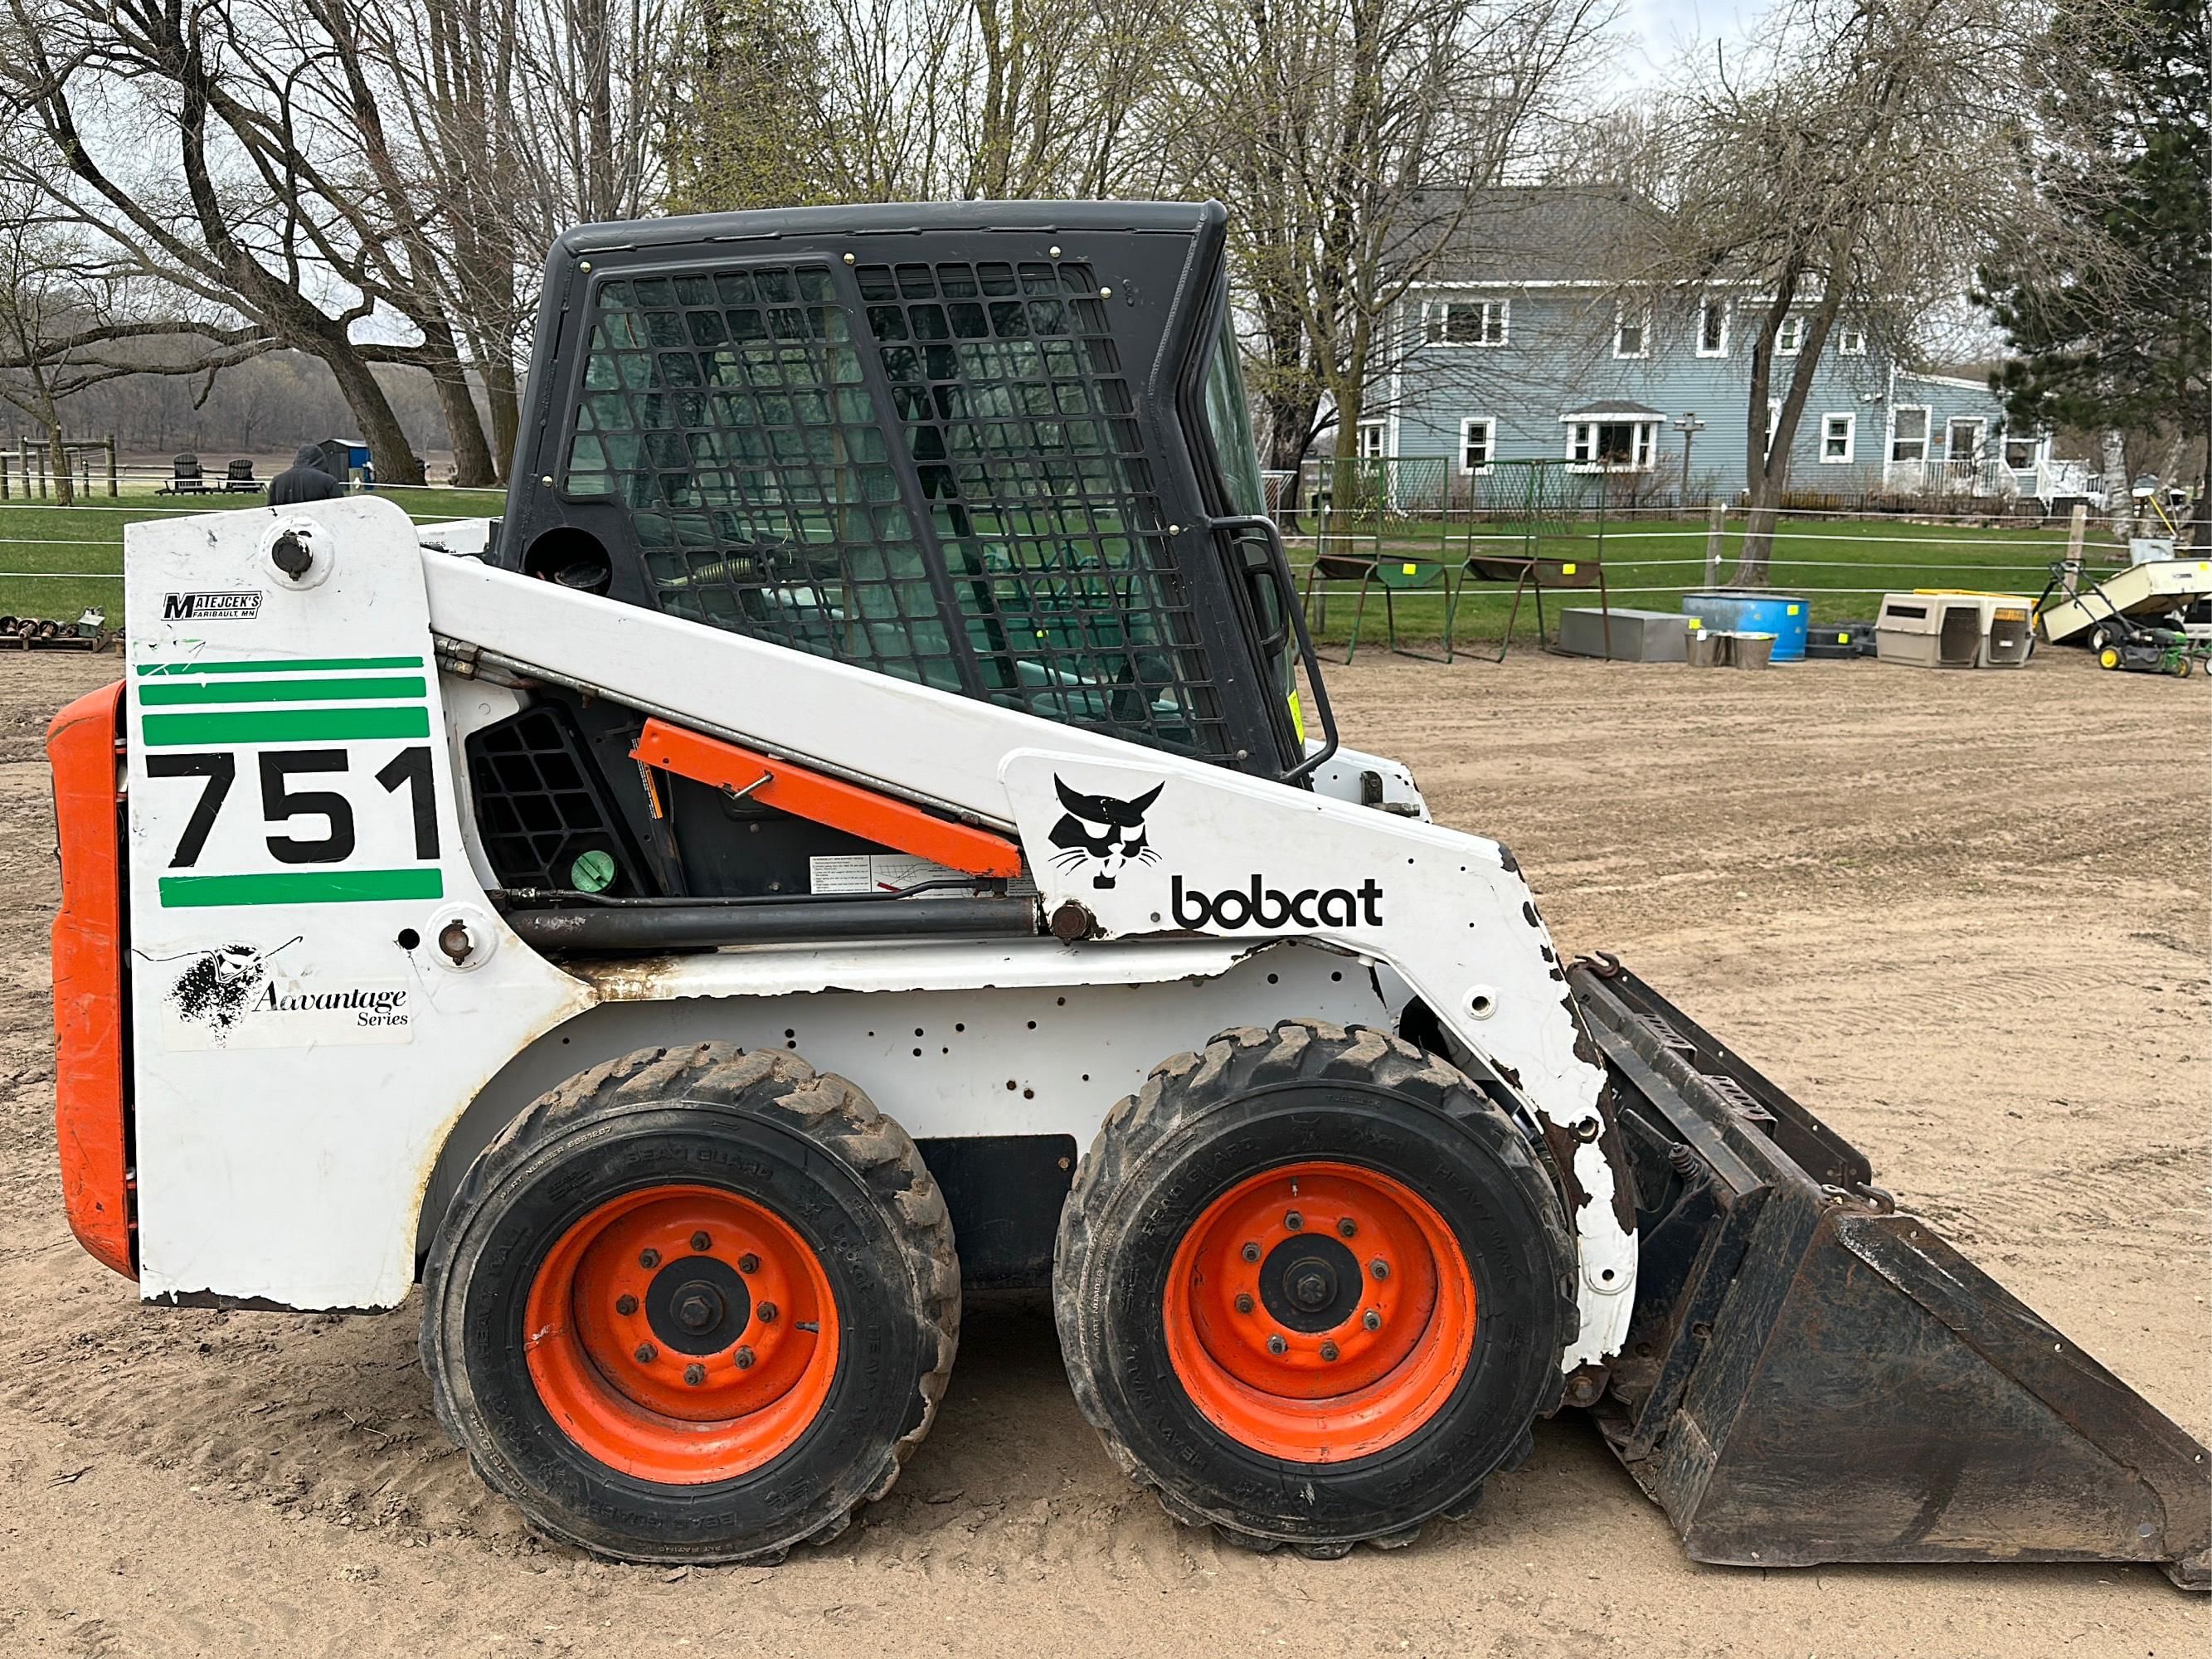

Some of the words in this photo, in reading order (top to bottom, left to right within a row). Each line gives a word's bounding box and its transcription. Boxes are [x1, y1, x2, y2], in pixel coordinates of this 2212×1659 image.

[163, 594, 260, 619] MATEJCEK'S
[145, 746, 441, 868] 751
[1171, 873, 1383, 930] bobcat
[357, 1011, 409, 1027] Series
